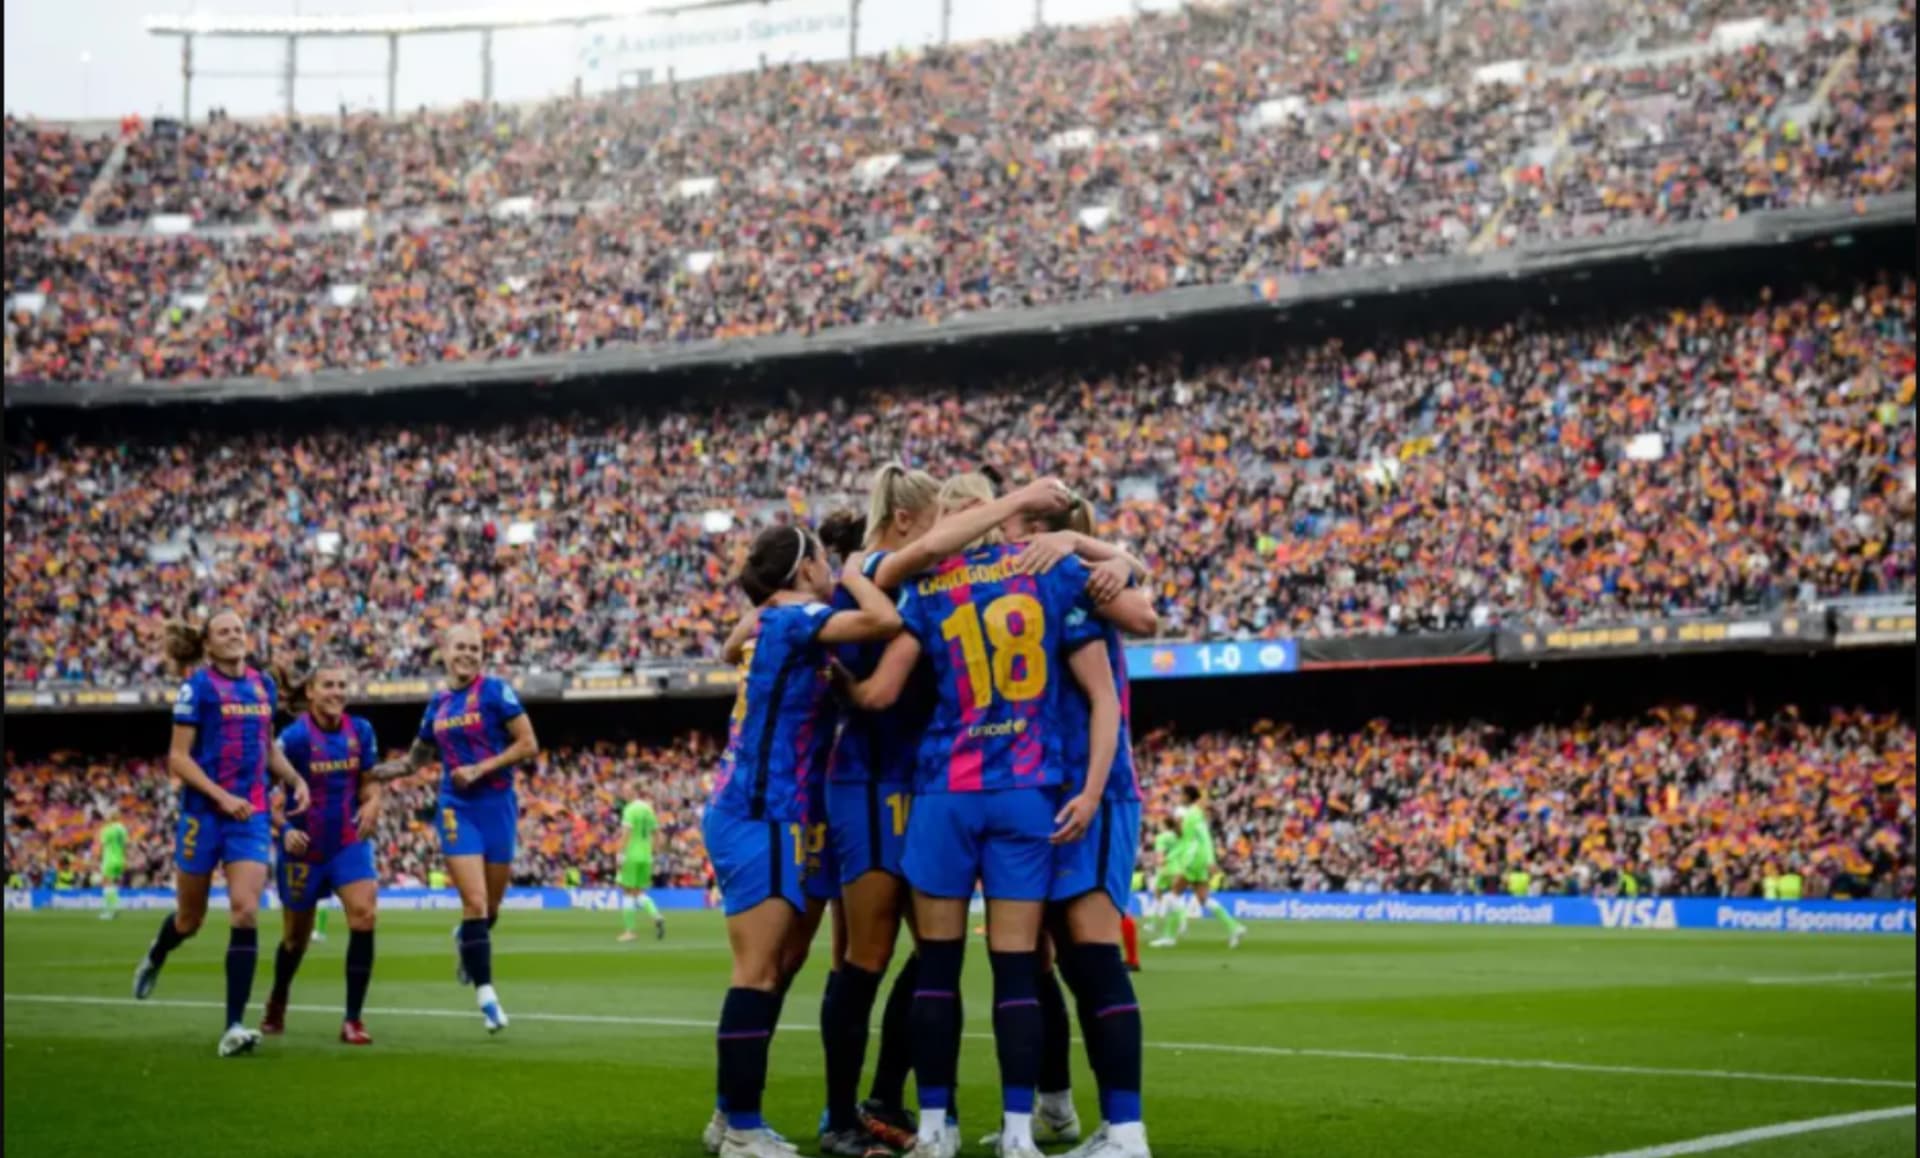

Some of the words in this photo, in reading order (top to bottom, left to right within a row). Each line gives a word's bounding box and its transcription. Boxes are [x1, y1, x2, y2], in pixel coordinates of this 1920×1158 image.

[941, 593, 1047, 709] 18
[1197, 644, 1241, 672] 1-0
[184, 816, 200, 848] 2
[1234, 899, 1287, 917] Proud
[1290, 899, 1360, 920] Sponsor
[1364, 900, 1386, 919] of
[1387, 902, 1471, 921] Women's
[1474, 903, 1553, 923] Football
[1597, 900, 1677, 928] VISA
[1716, 905, 1784, 928] Proud
[1786, 906, 1877, 931] Sponsor
[1880, 908, 1903, 930] of
